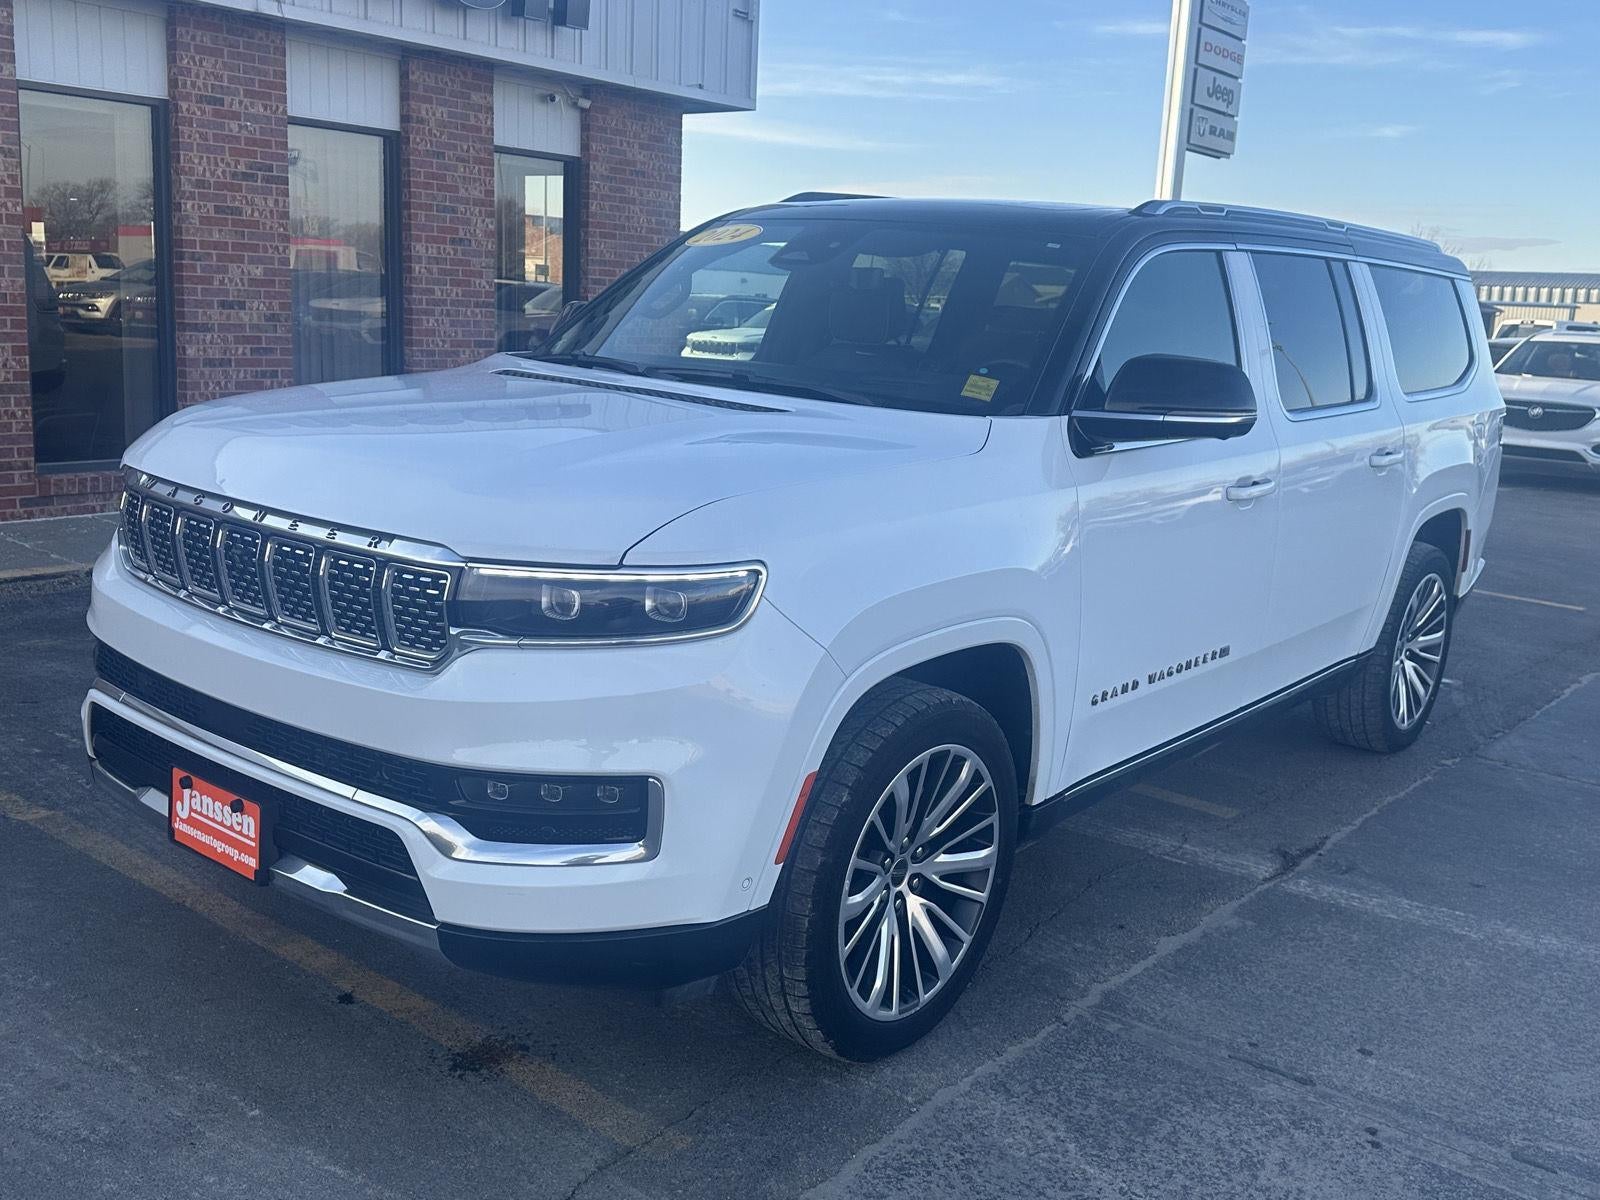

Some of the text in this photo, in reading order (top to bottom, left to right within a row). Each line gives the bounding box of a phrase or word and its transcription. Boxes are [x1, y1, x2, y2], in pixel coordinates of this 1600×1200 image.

[1204, 41, 1243, 64] DODGE
[1207, 76, 1234, 108] Jeep
[1208, 125, 1235, 142] RAM
[136, 473, 383, 549] WAGONEER
[1091, 679, 1139, 706] GRAND
[1147, 650, 1218, 684] WAGONEER
[176, 788, 256, 838] Janssen
[174, 817, 256, 867] Janssenautogroup.com
